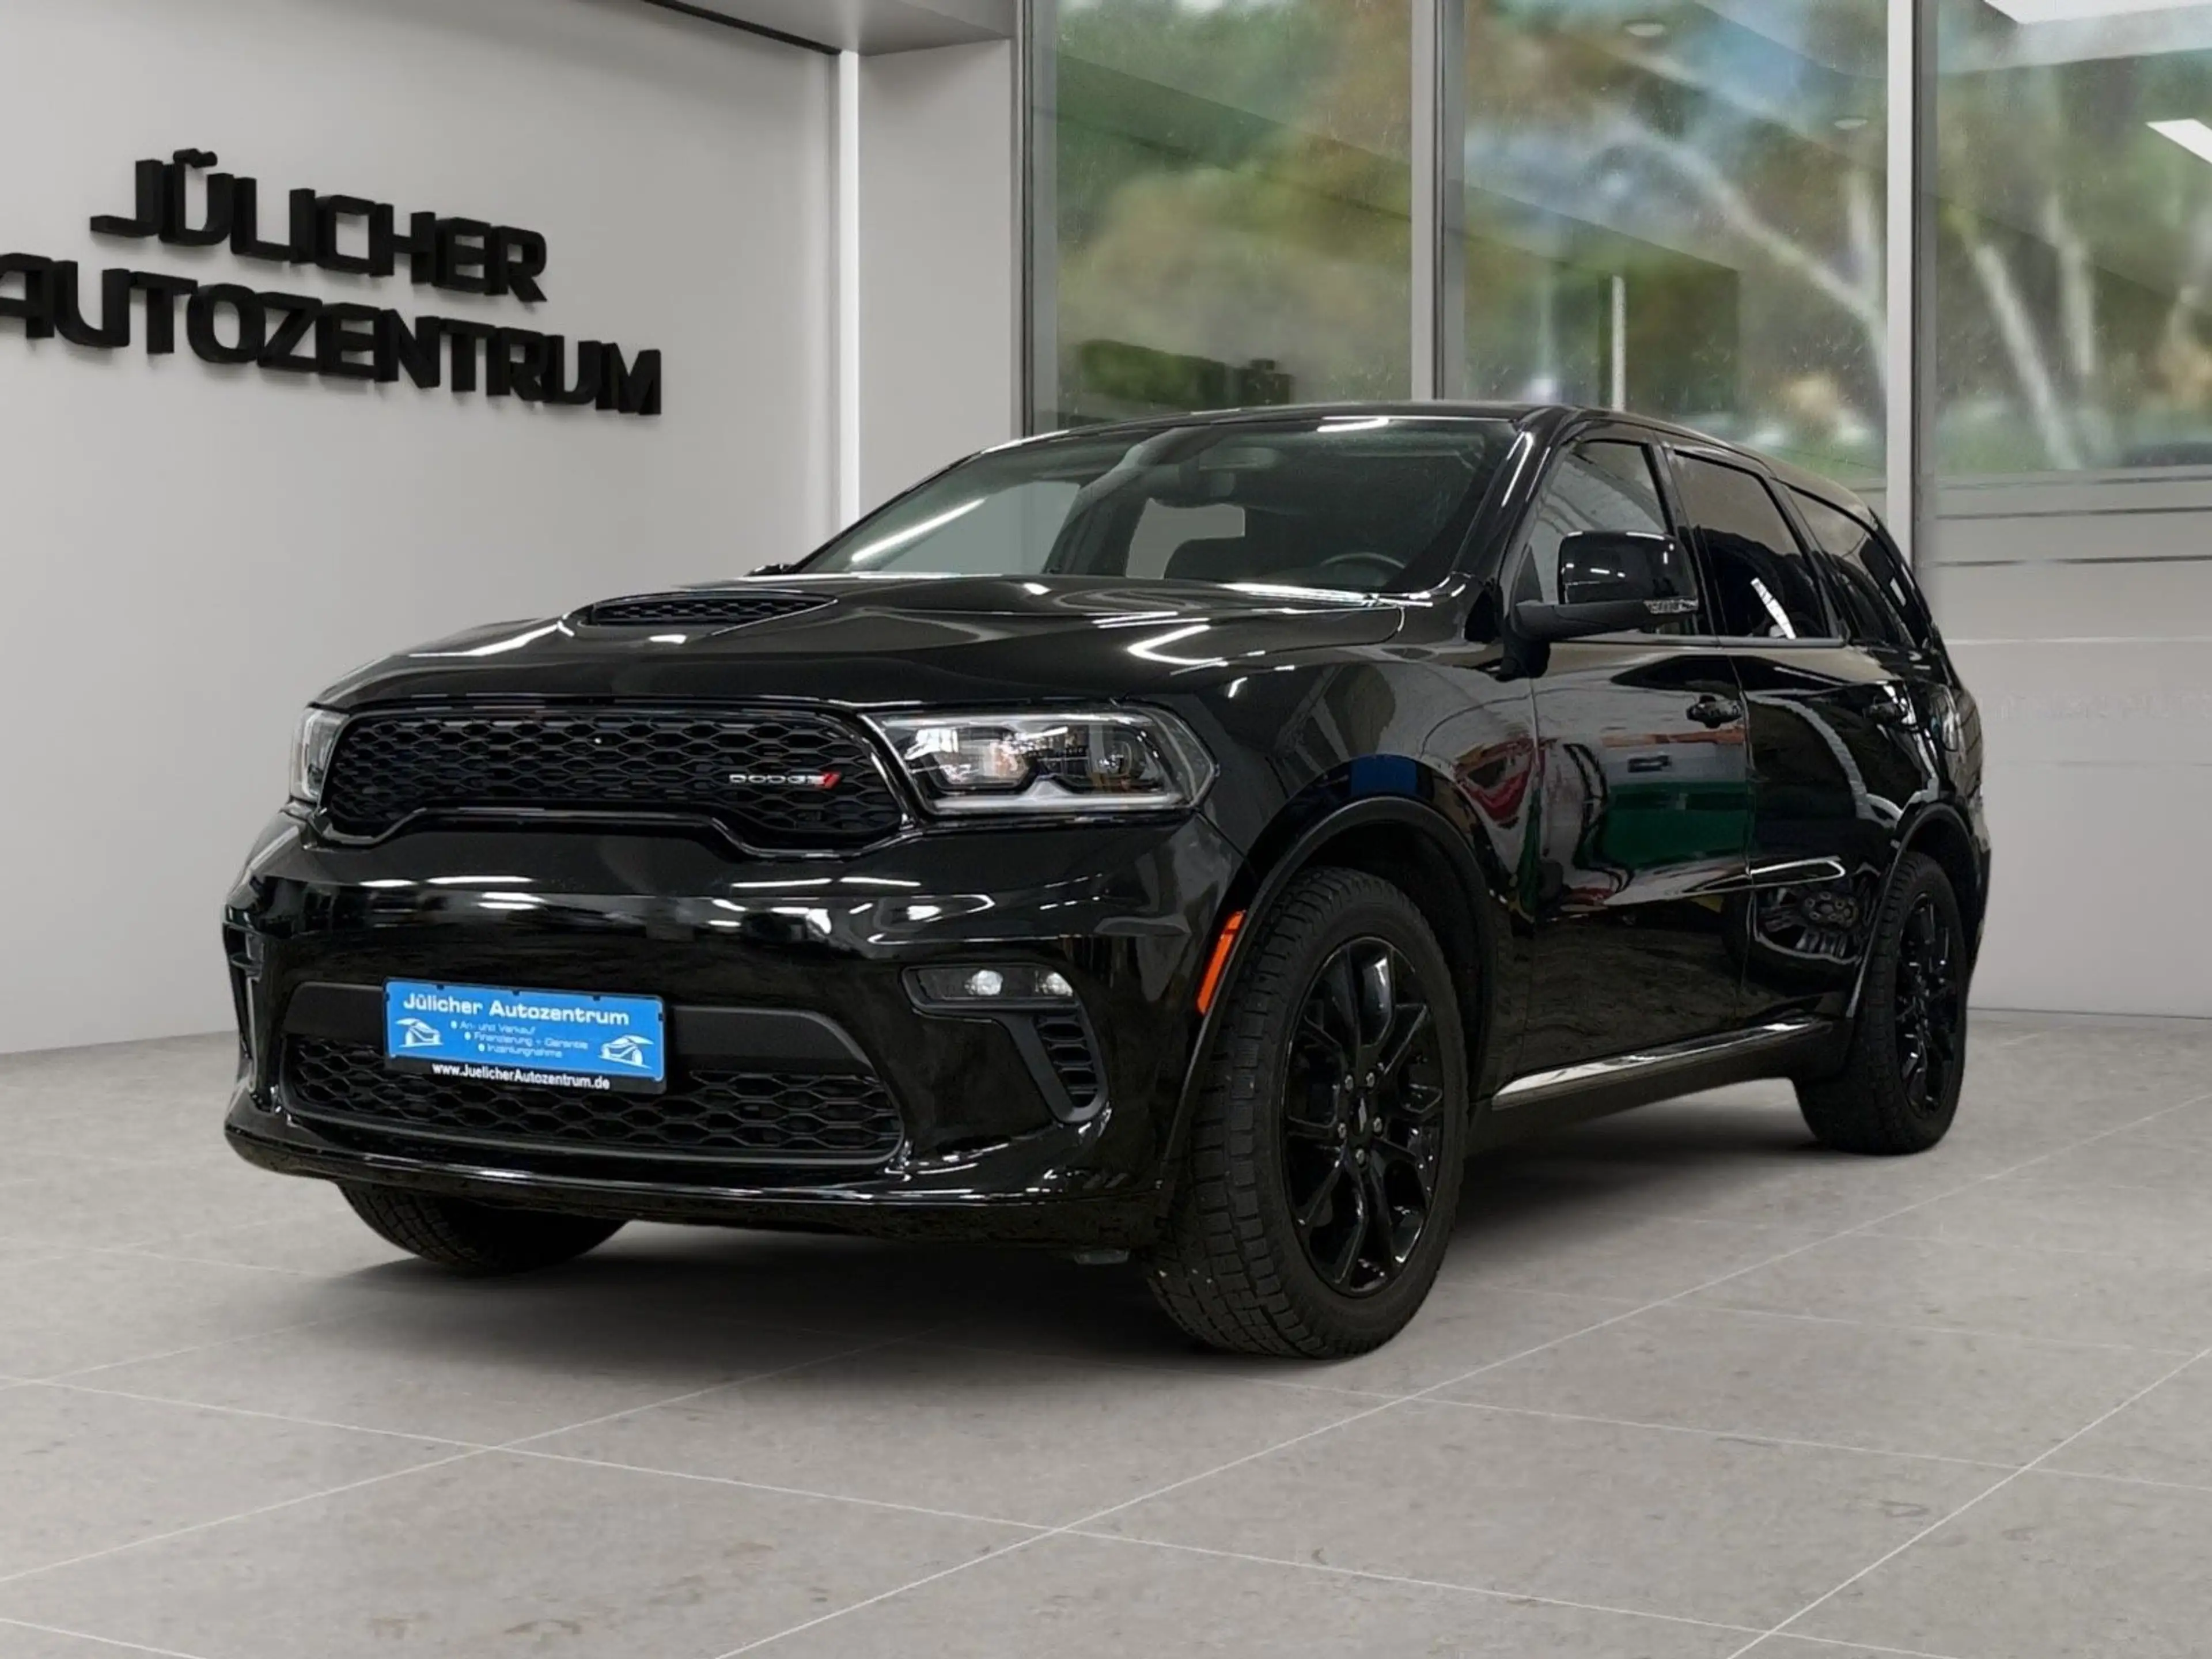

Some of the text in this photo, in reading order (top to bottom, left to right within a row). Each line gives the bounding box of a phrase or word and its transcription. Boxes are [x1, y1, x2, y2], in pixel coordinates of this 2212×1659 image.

[90, 147, 548, 302] JÜLICHER
[0, 252, 662, 415] AUTOZENTRUM
[729, 774, 826, 785] DODGE
[403, 992, 630, 1026] Jülicher Autozentrum
[431, 1062, 611, 1090] www.JuelicherAutozentrum.de
